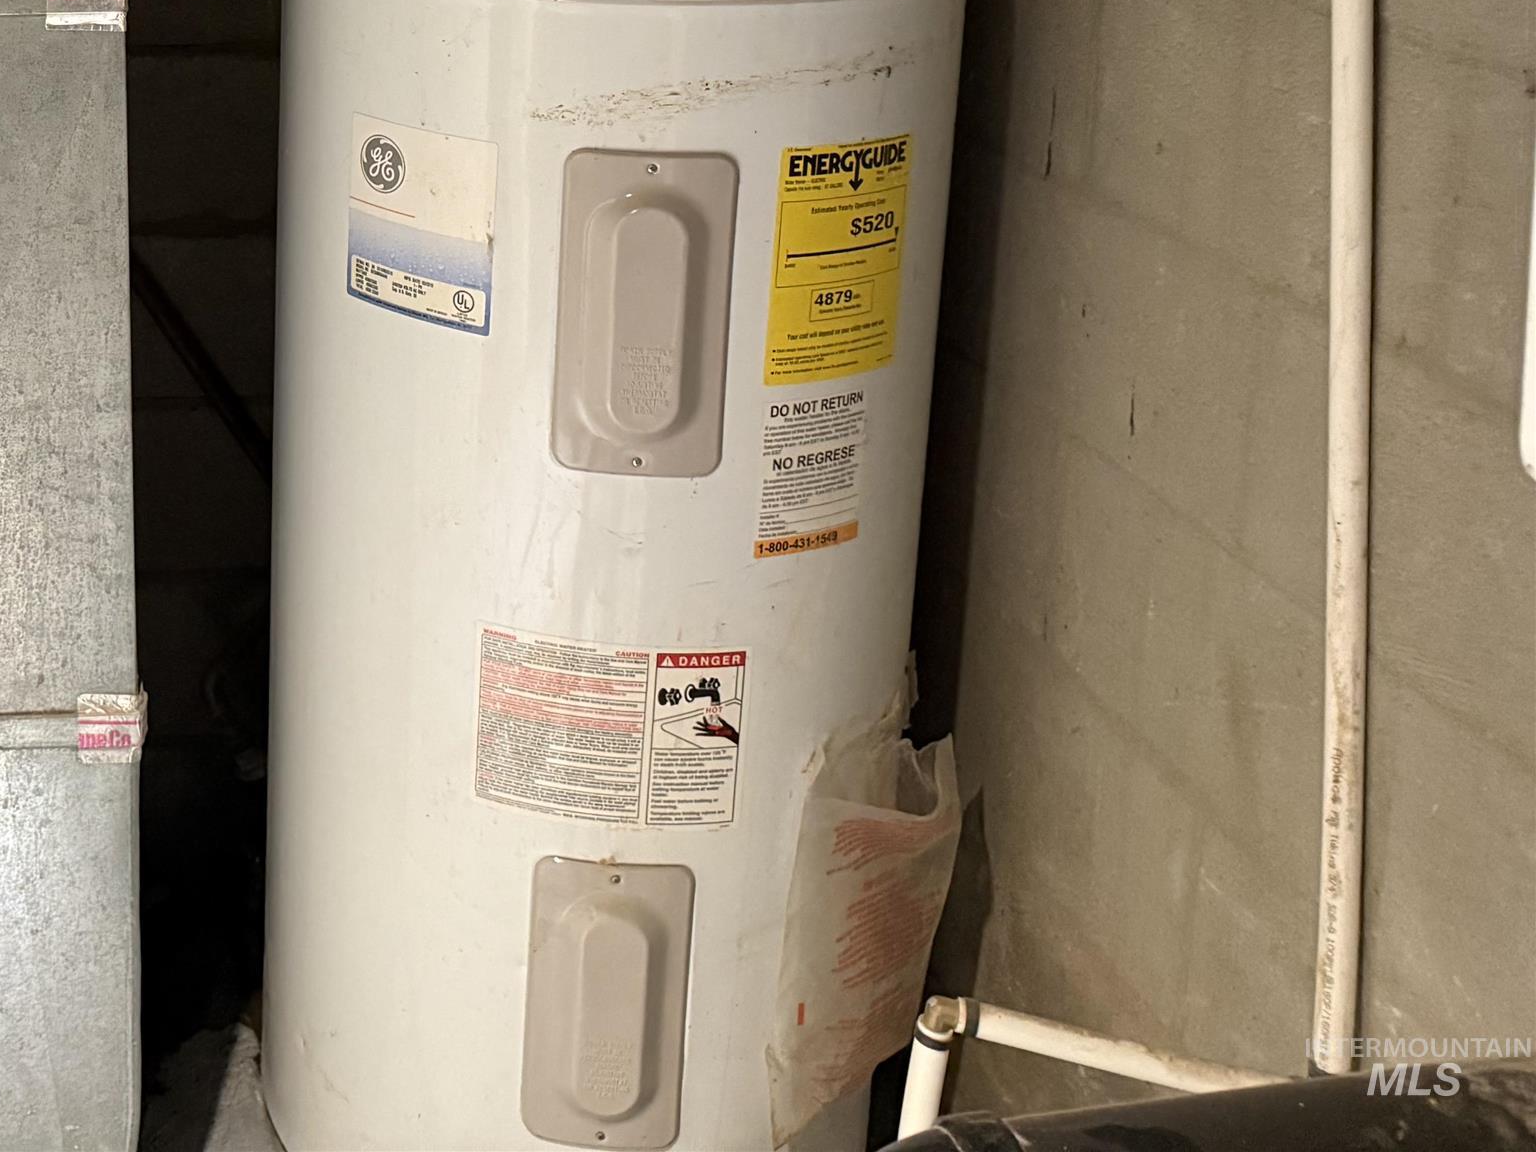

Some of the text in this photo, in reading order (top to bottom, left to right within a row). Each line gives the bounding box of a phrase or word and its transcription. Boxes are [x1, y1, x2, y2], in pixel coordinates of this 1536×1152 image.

[789, 140, 907, 180] ENERGYGUIDE
[811, 206, 837, 215] Estimated
[850, 211, 895, 237] $520
[815, 289, 853, 307] 4879
[770, 391, 864, 418] DO NOT RETURN
[773, 444, 855, 471] NO REGRESE
[679, 654, 741, 666] DANGER
